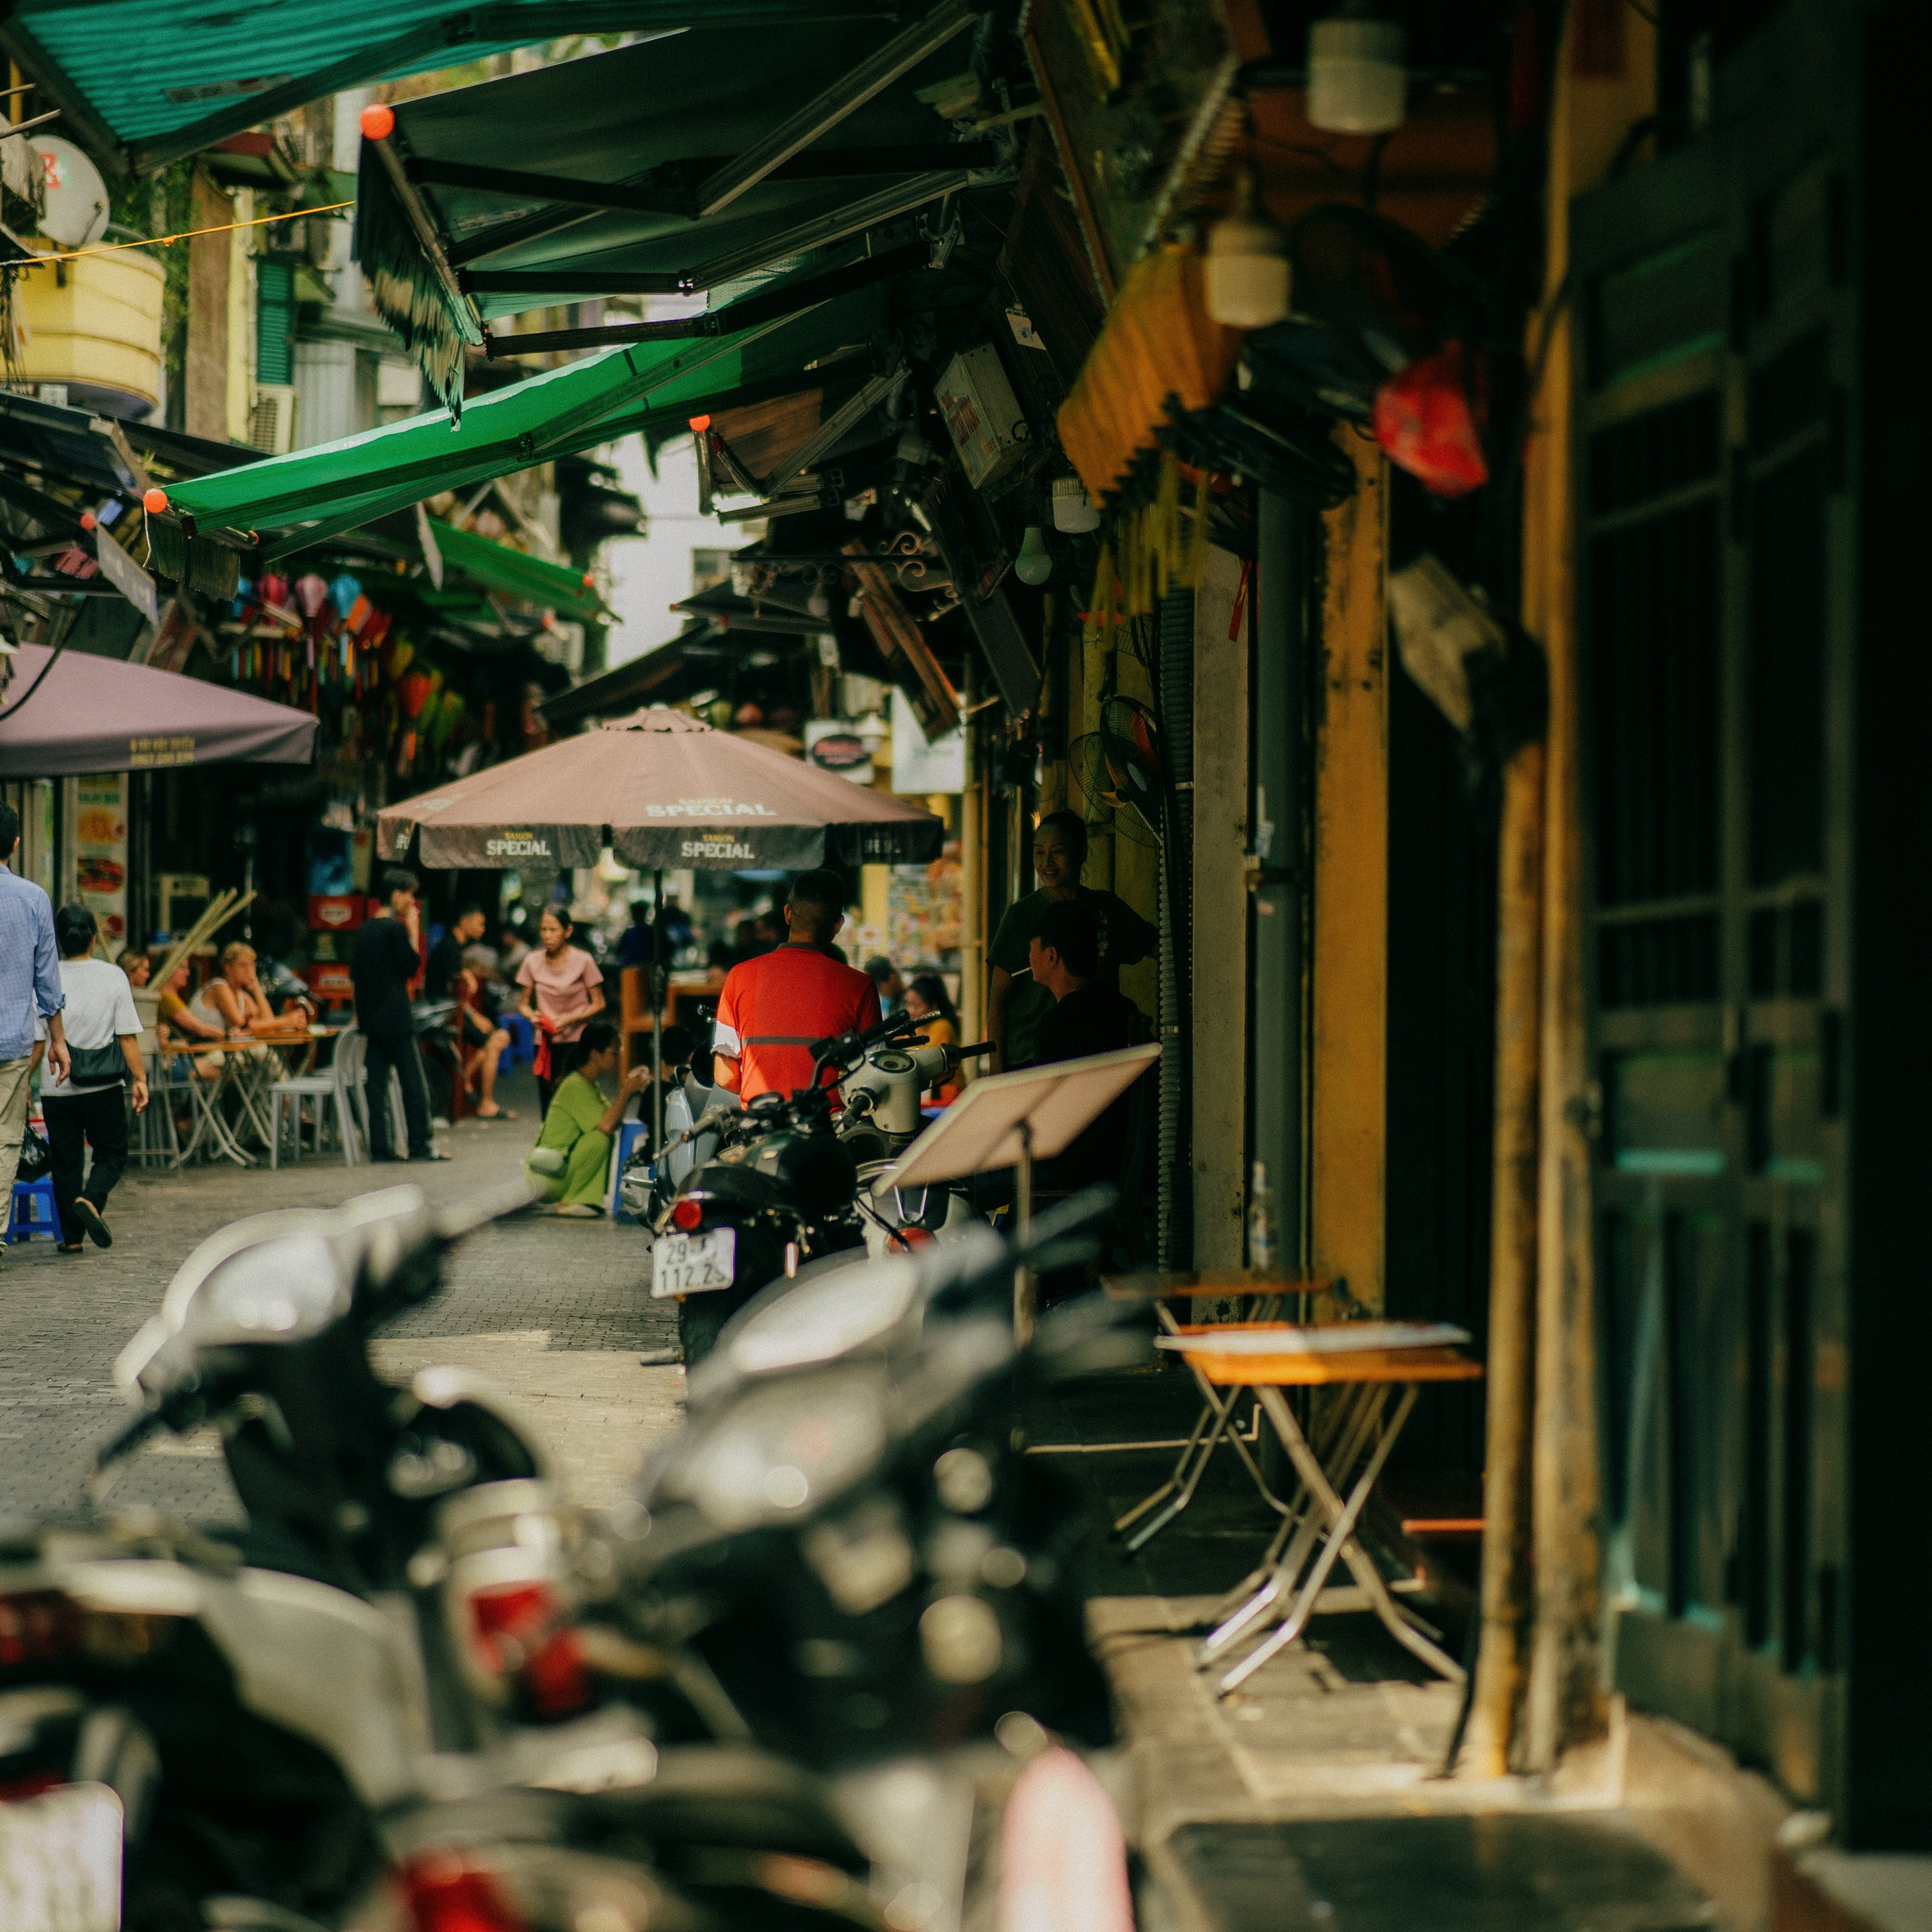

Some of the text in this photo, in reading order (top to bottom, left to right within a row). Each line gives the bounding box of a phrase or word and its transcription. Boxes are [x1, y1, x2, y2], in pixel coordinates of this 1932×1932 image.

[646, 803, 777, 817] SPECIAL
[486, 839, 552, 855] SPECIAL
[681, 840, 755, 859] SPECIAL
